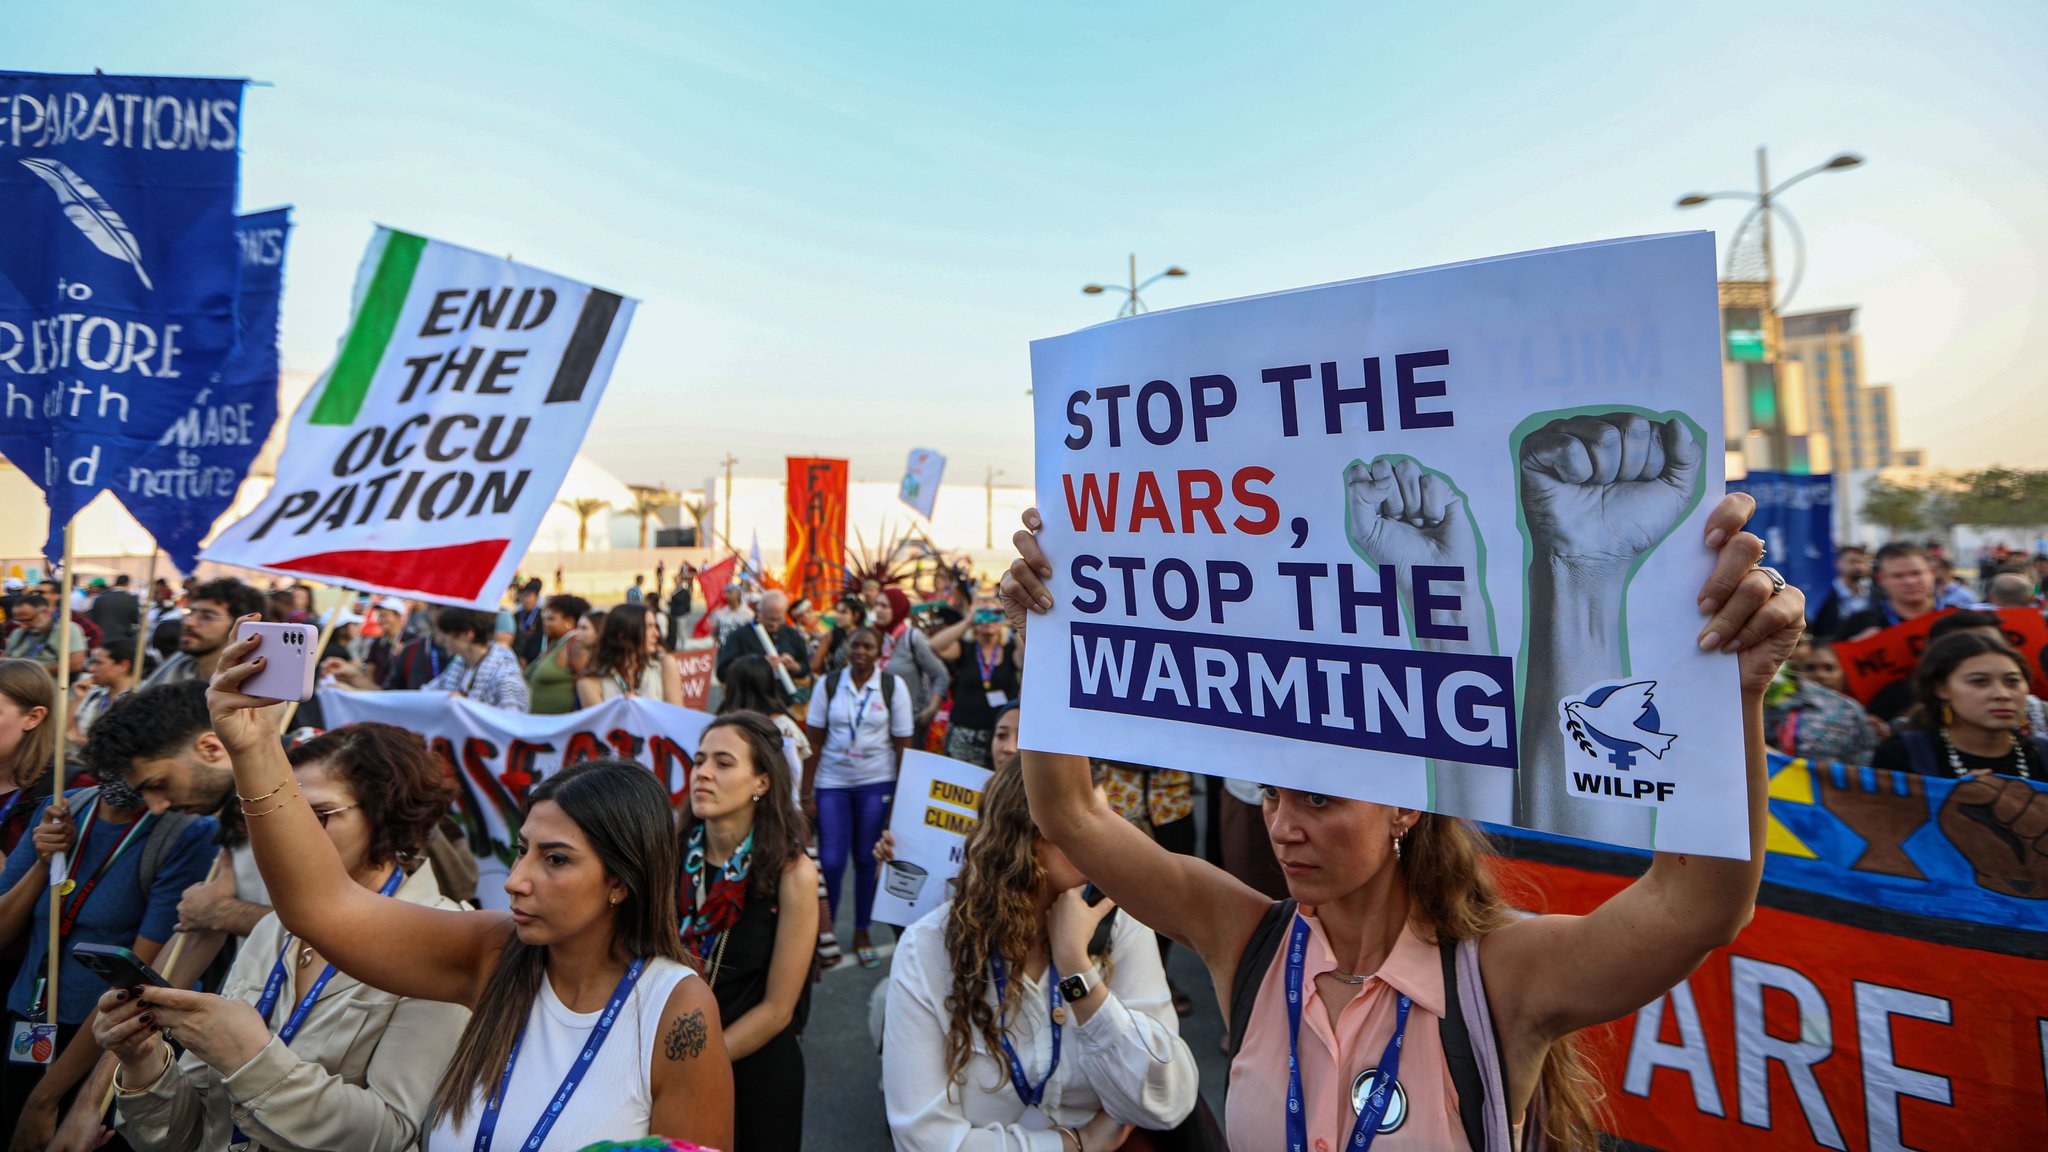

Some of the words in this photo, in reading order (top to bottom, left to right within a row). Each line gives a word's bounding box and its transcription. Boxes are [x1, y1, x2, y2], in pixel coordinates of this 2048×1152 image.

[58, 277, 93, 300] to
[418, 287, 557, 338] END
[397, 346, 529, 404] THE
[1064, 374, 1237, 452] STOP
[1261, 348, 1455, 438] THE
[332, 413, 532, 478] OCCU
[128, 465, 236, 500] nature
[247, 469, 533, 542] PATION
[1062, 466, 1310, 549] WARS,
[1070, 554, 1254, 624] STOP
[1278, 561, 1470, 642] THE
[1073, 634, 1509, 749] WARMING
[932, 780, 974, 805] FUND
[1573, 771, 1676, 802] WILPF
[1622, 953, 1954, 1152] ARE
